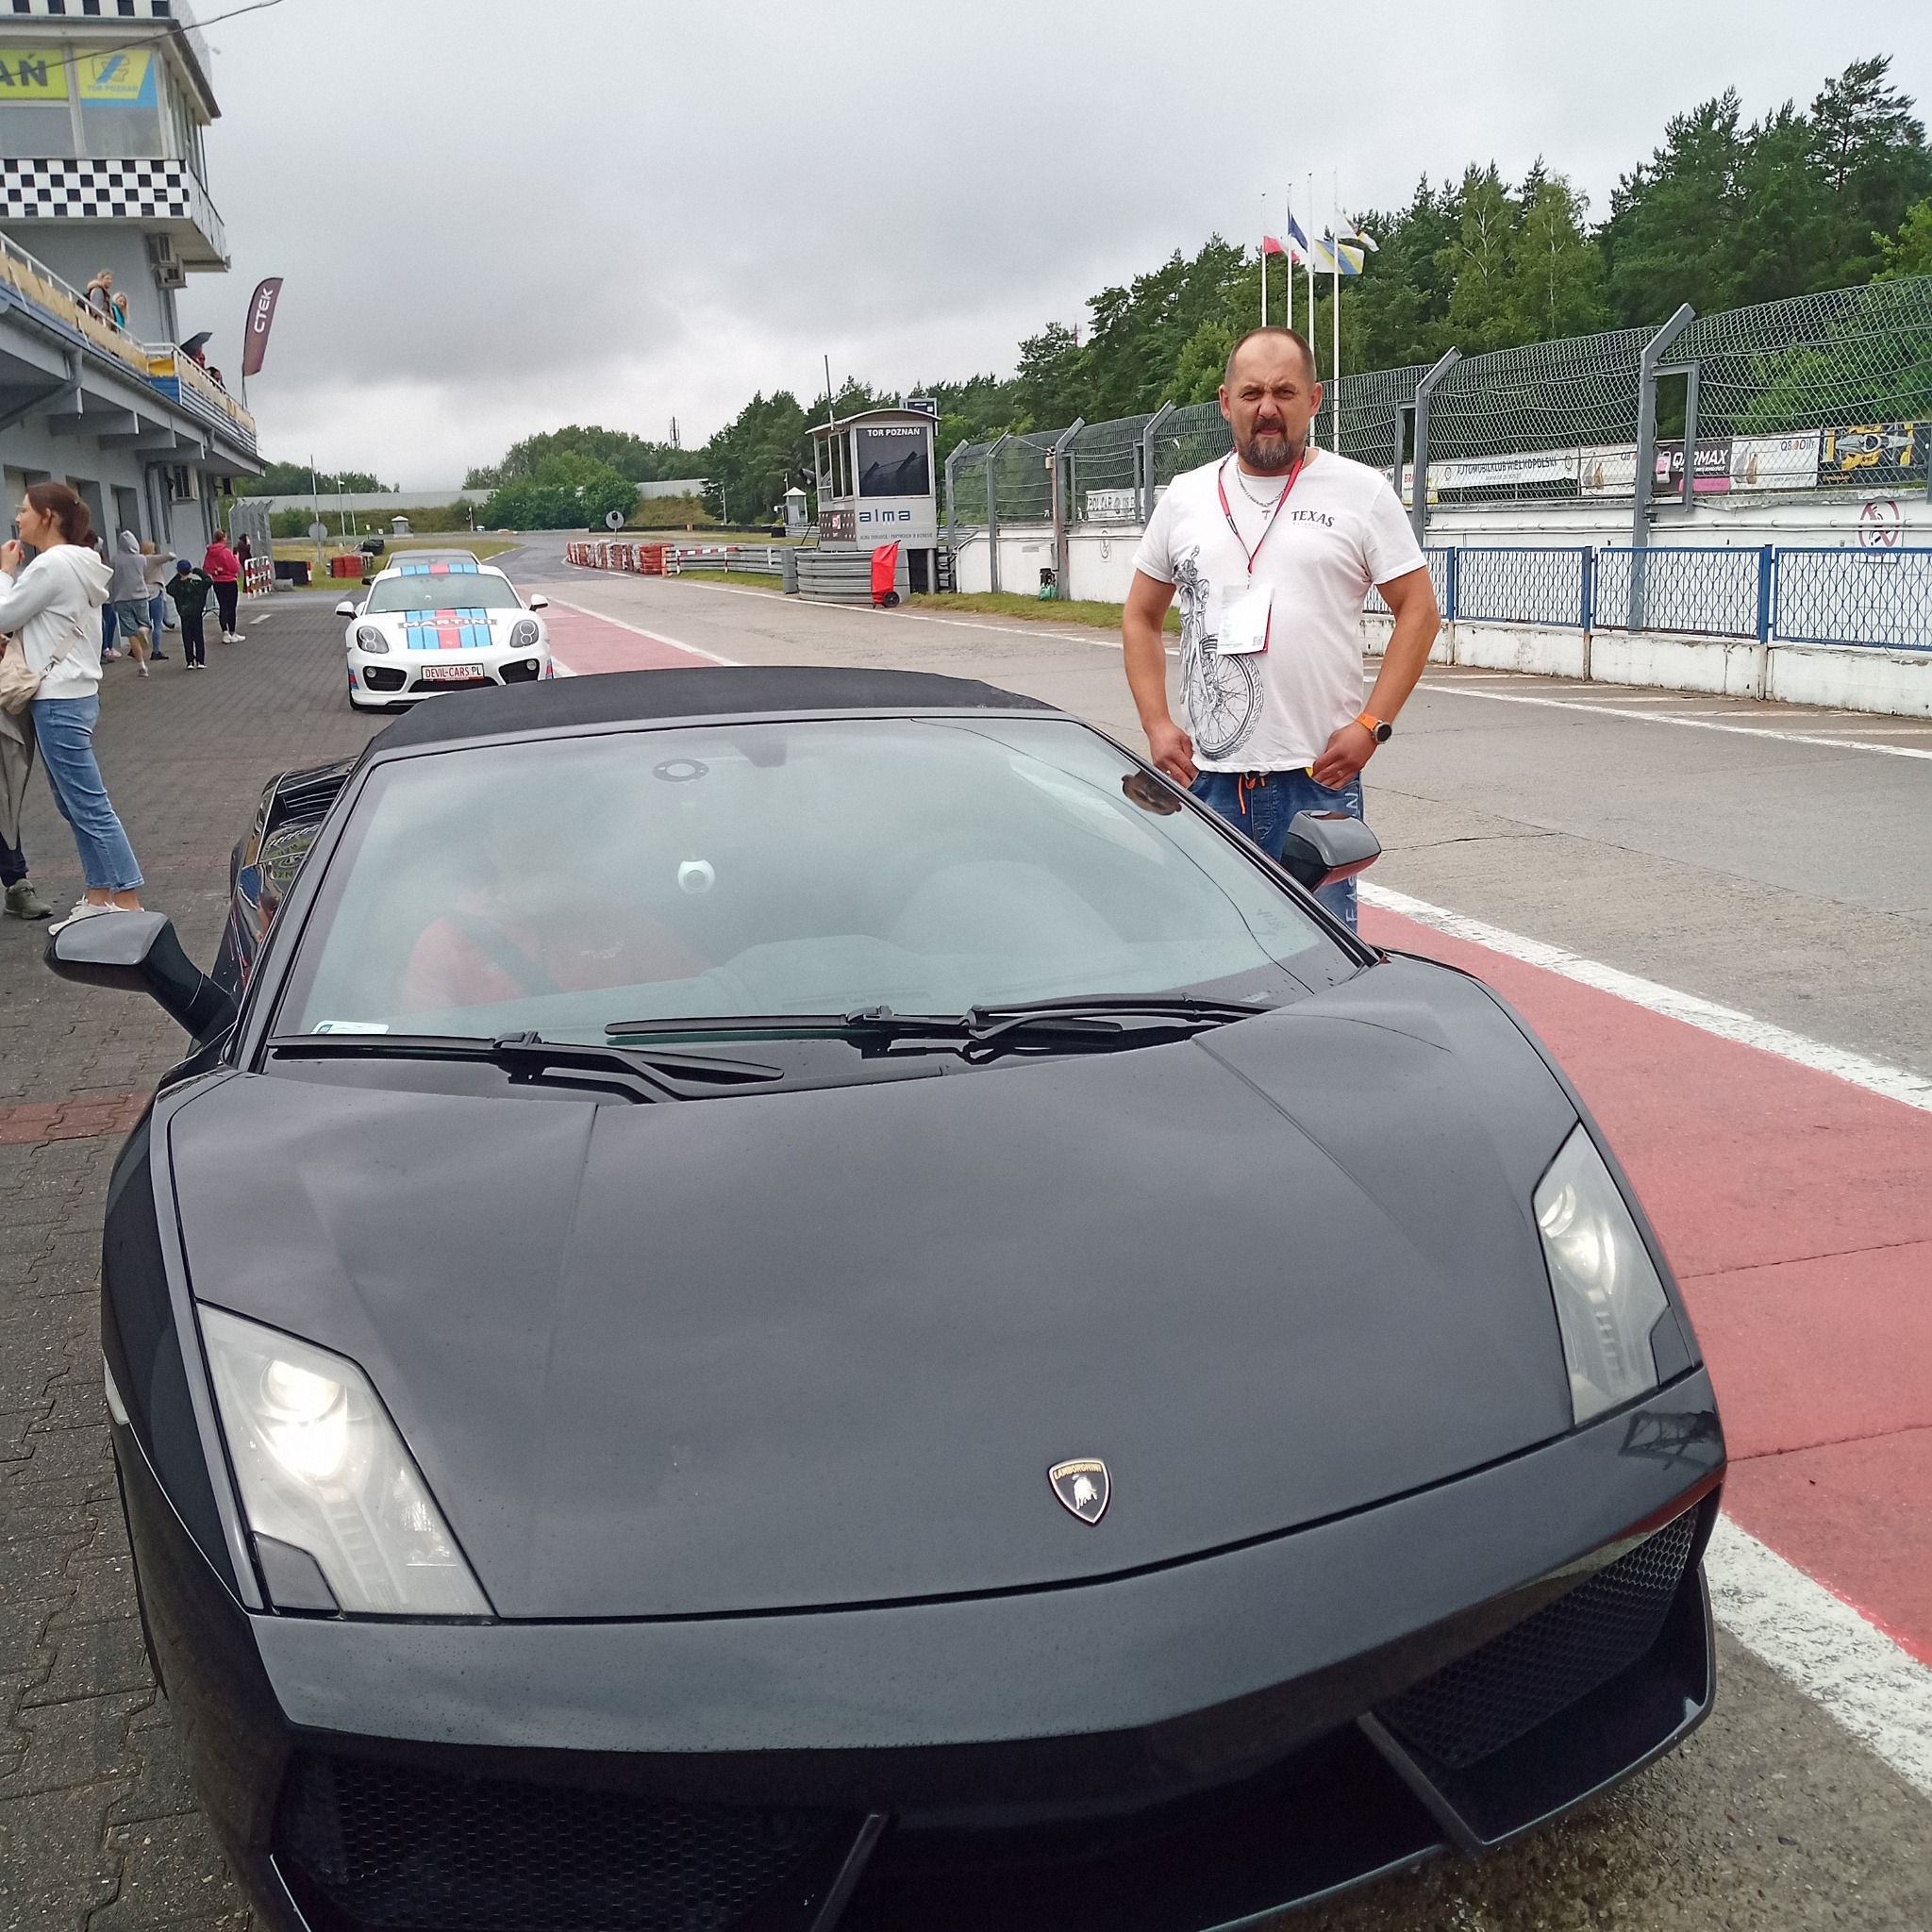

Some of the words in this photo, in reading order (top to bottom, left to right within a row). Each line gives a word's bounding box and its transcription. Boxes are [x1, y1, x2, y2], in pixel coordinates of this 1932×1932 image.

[254, 288, 274, 333] CTEK
[867, 428, 884, 437] TOR
[858, 508, 910, 523] alma
[1291, 510, 1336, 528] TEXAS
[404, 619, 491, 628] MARTINI
[1054, 1463, 1102, 1480] LAMBORGHINI
